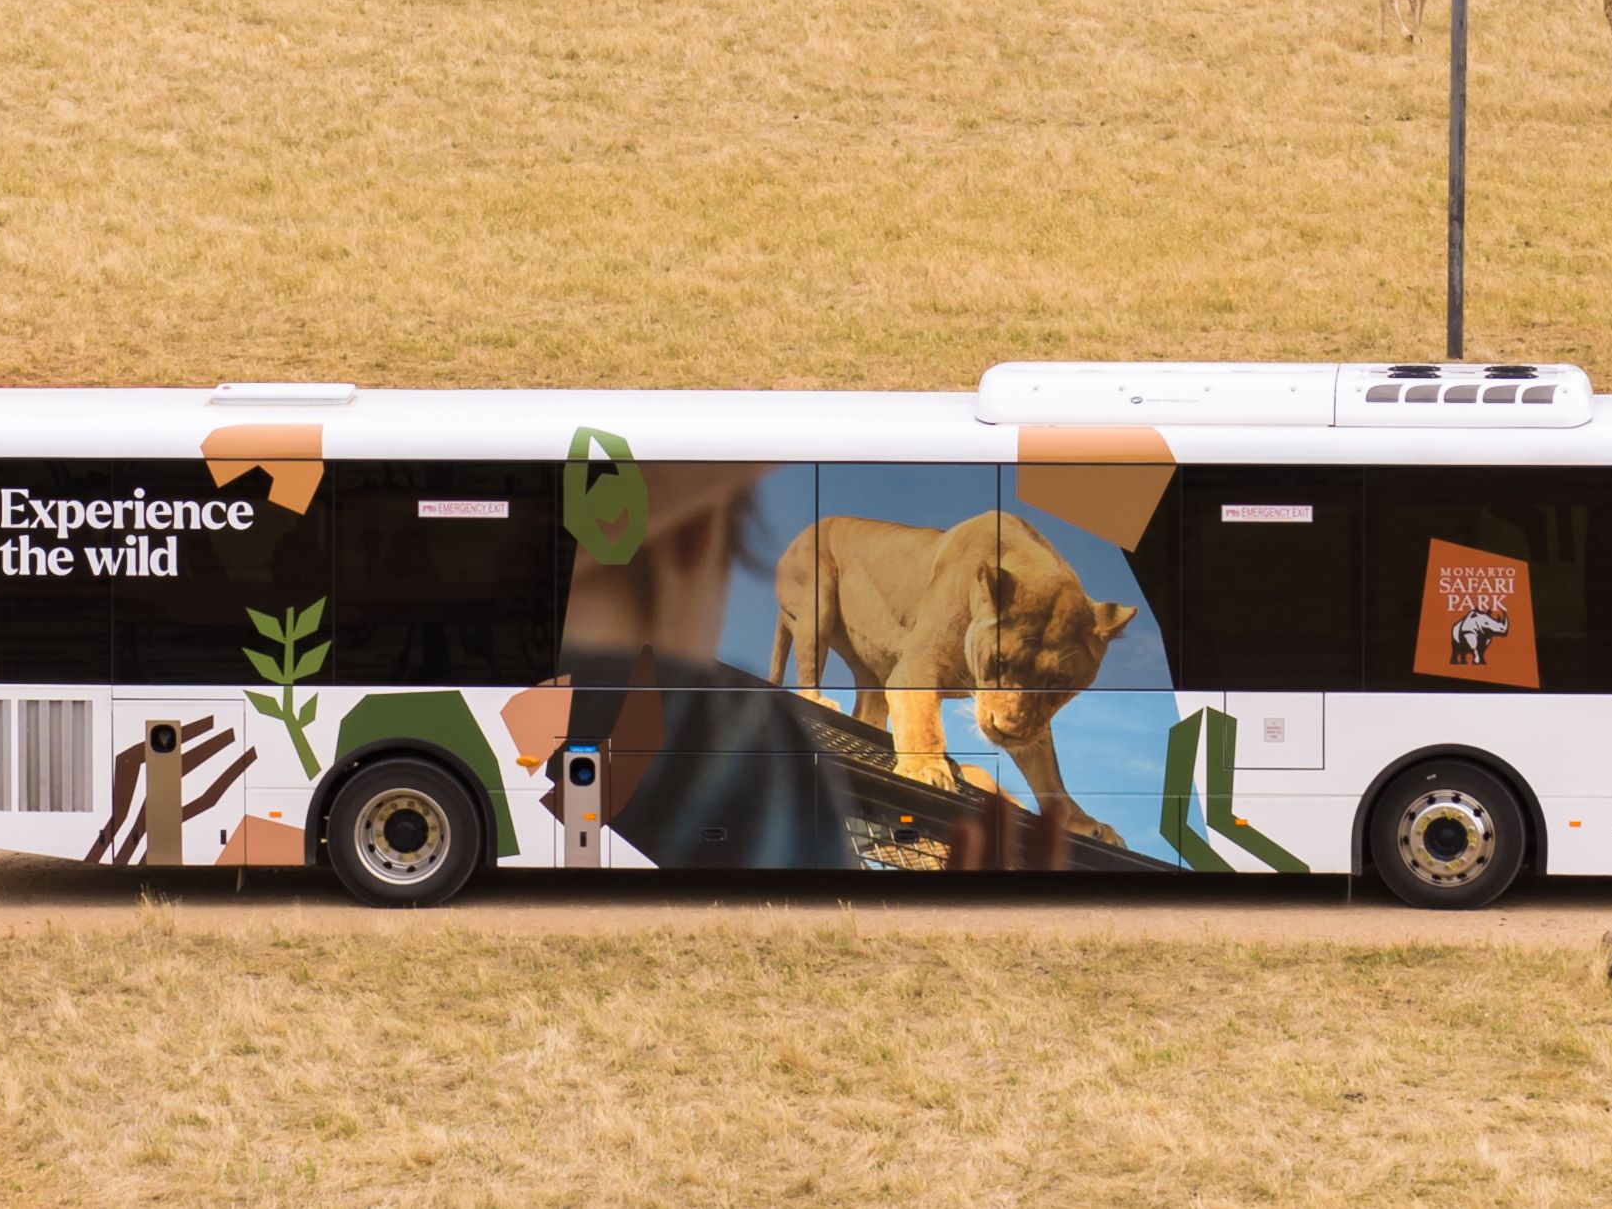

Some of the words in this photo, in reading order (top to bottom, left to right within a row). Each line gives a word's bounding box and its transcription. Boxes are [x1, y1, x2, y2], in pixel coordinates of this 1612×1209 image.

[0, 487, 254, 539] Experience
[438, 503, 486, 513] EMERGENCY
[488, 503, 505, 513] EXIT
[1241, 507, 1290, 518] EMERGENCY
[1292, 507, 1309, 518] EXIT
[84, 534, 179, 577] wild
[1440, 567, 1516, 577] MONARTO
[1439, 577, 1515, 593] SAFARI
[1447, 594, 1508, 611] PARK
